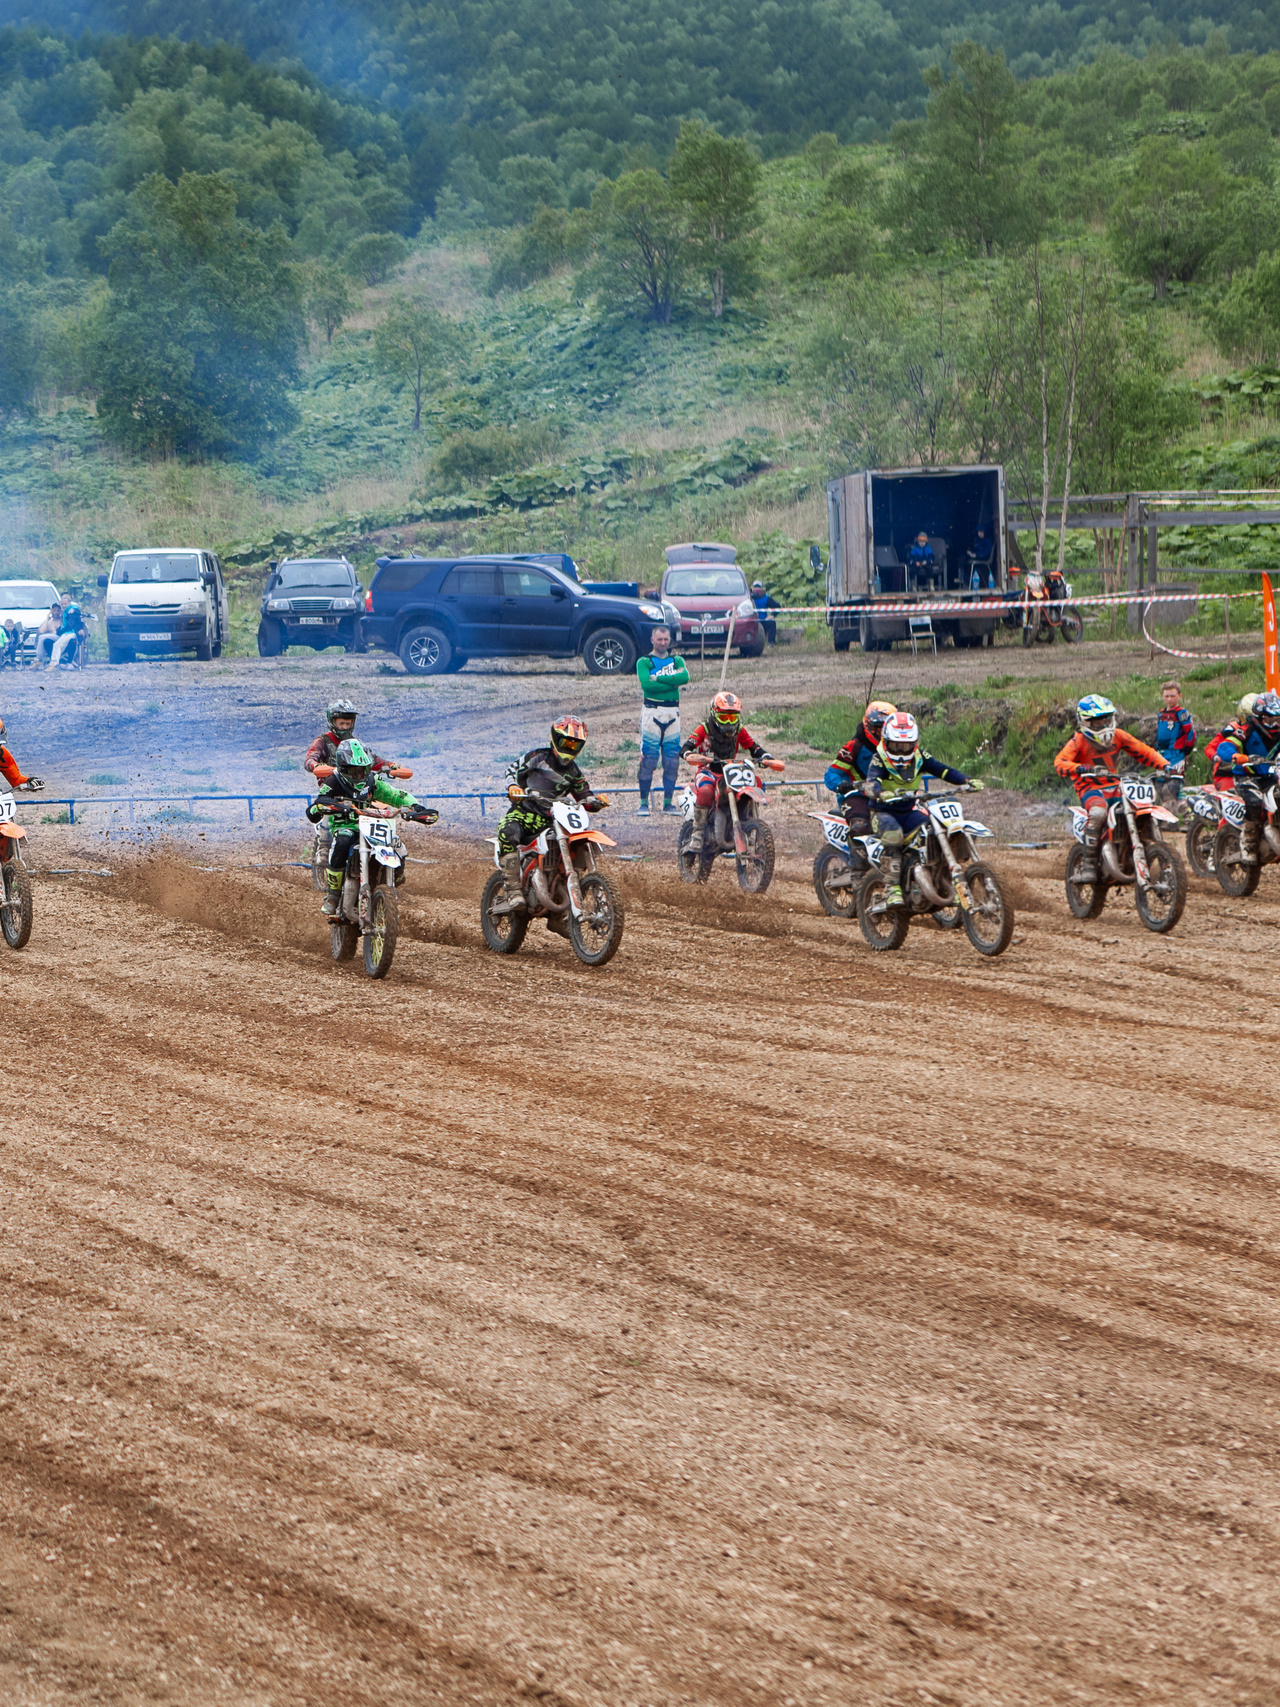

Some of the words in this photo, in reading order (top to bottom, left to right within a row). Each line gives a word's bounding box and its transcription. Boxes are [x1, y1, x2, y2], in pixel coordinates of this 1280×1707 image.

[729, 768, 755, 786] 29
[1127, 785, 1153, 800] 204
[939, 804, 959, 819] 60
[1225, 801, 1246, 819] 206
[567, 812, 583, 829] 6
[369, 823, 389, 838] 15
[827, 823, 849, 843] 203
